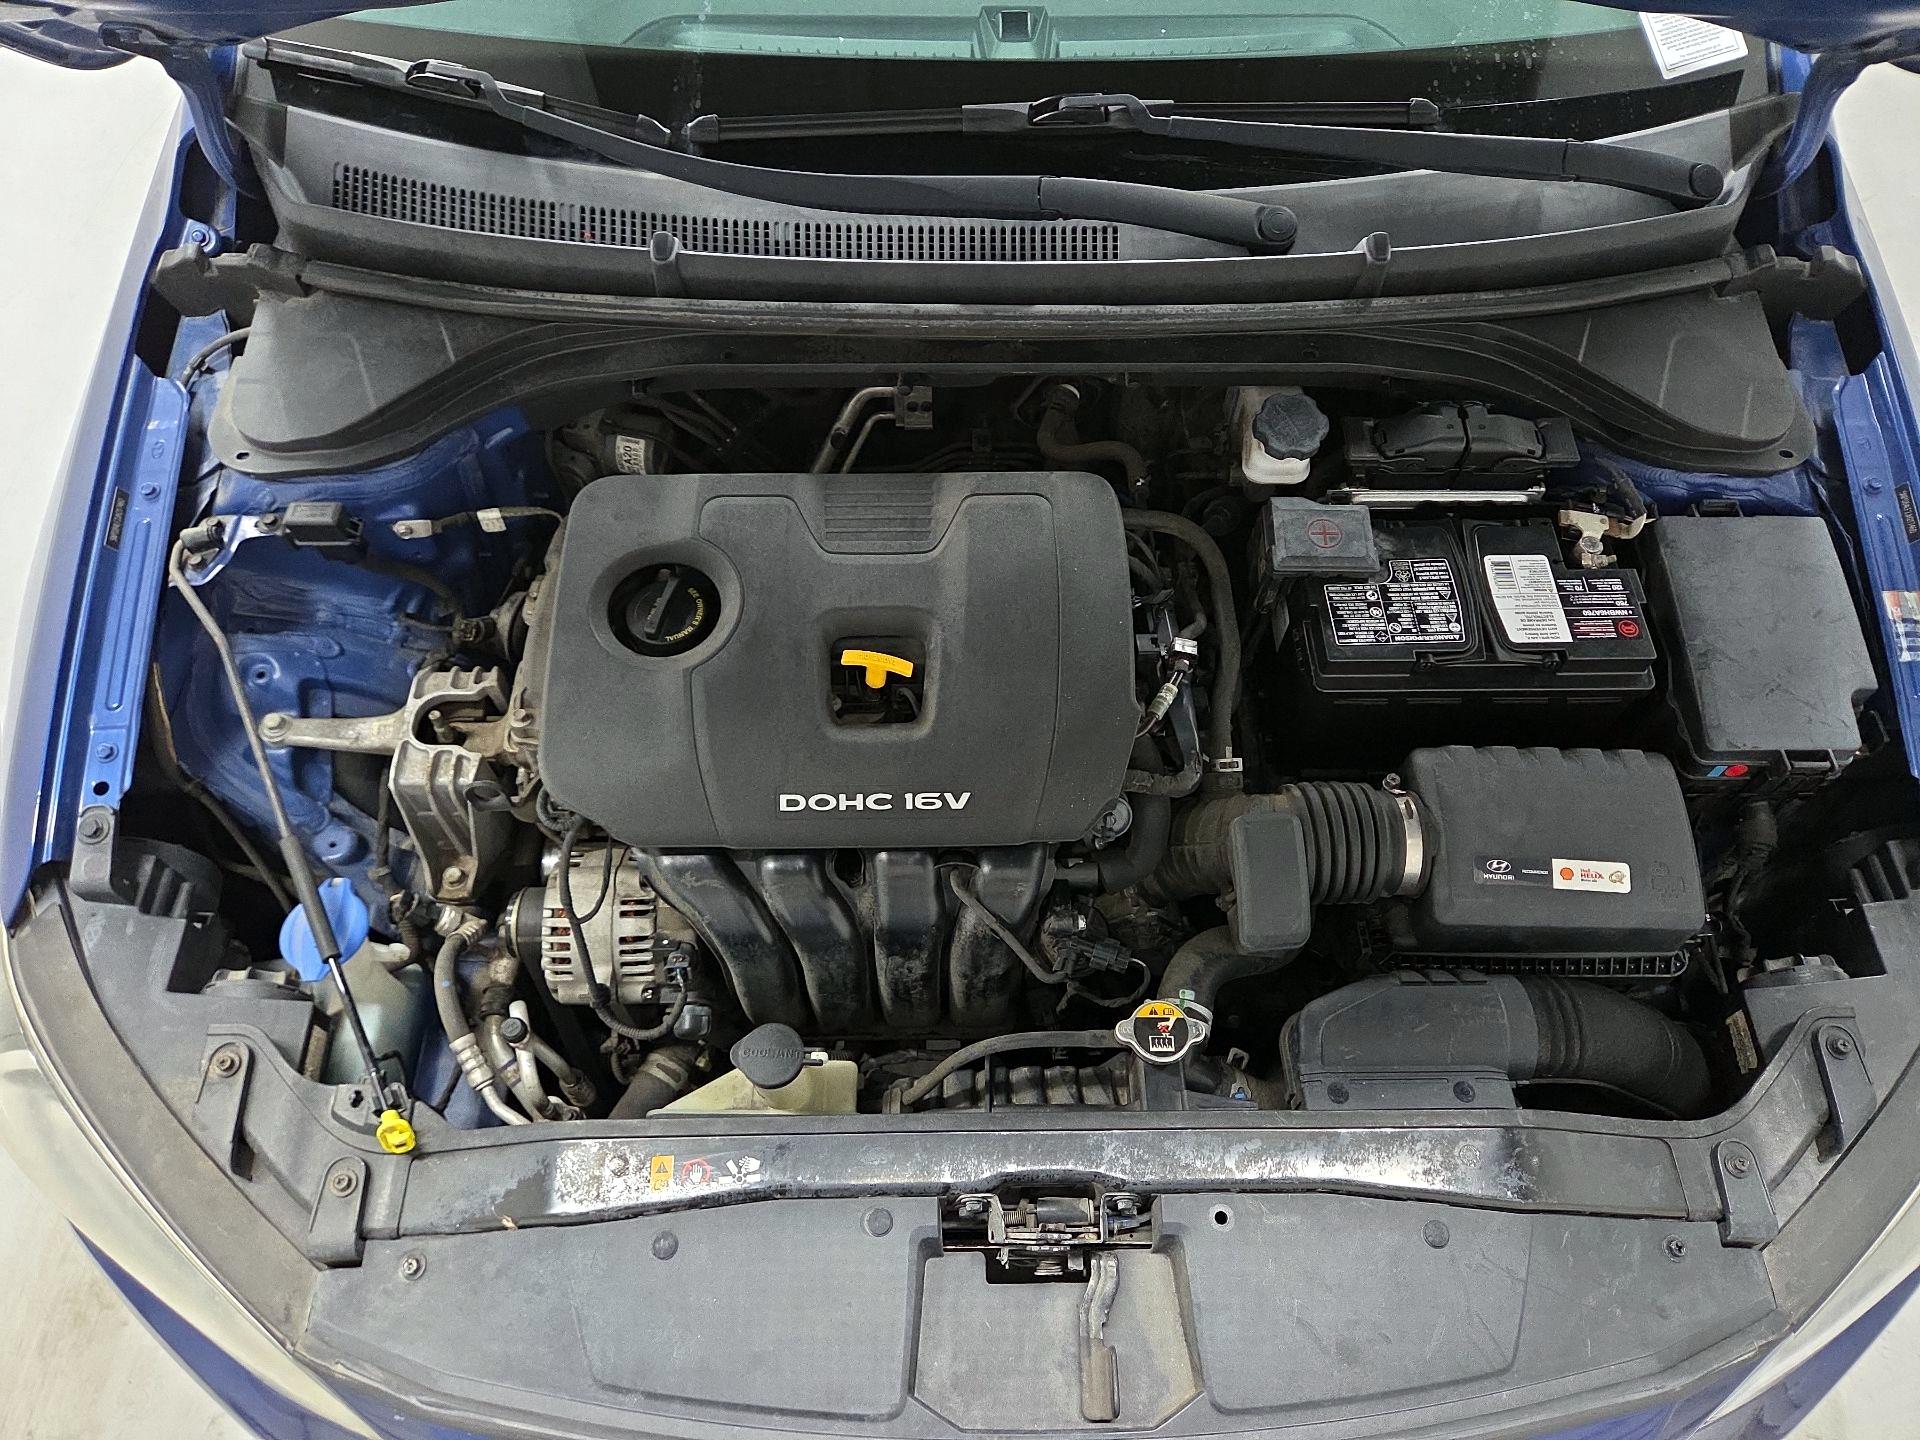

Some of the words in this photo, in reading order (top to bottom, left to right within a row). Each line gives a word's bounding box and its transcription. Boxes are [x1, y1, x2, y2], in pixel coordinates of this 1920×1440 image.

[623, 445, 633, 465] A20
[779, 793, 893, 811] DOHC
[904, 792, 971, 810] 16V
[742, 1046, 801, 1059] COOLANT
